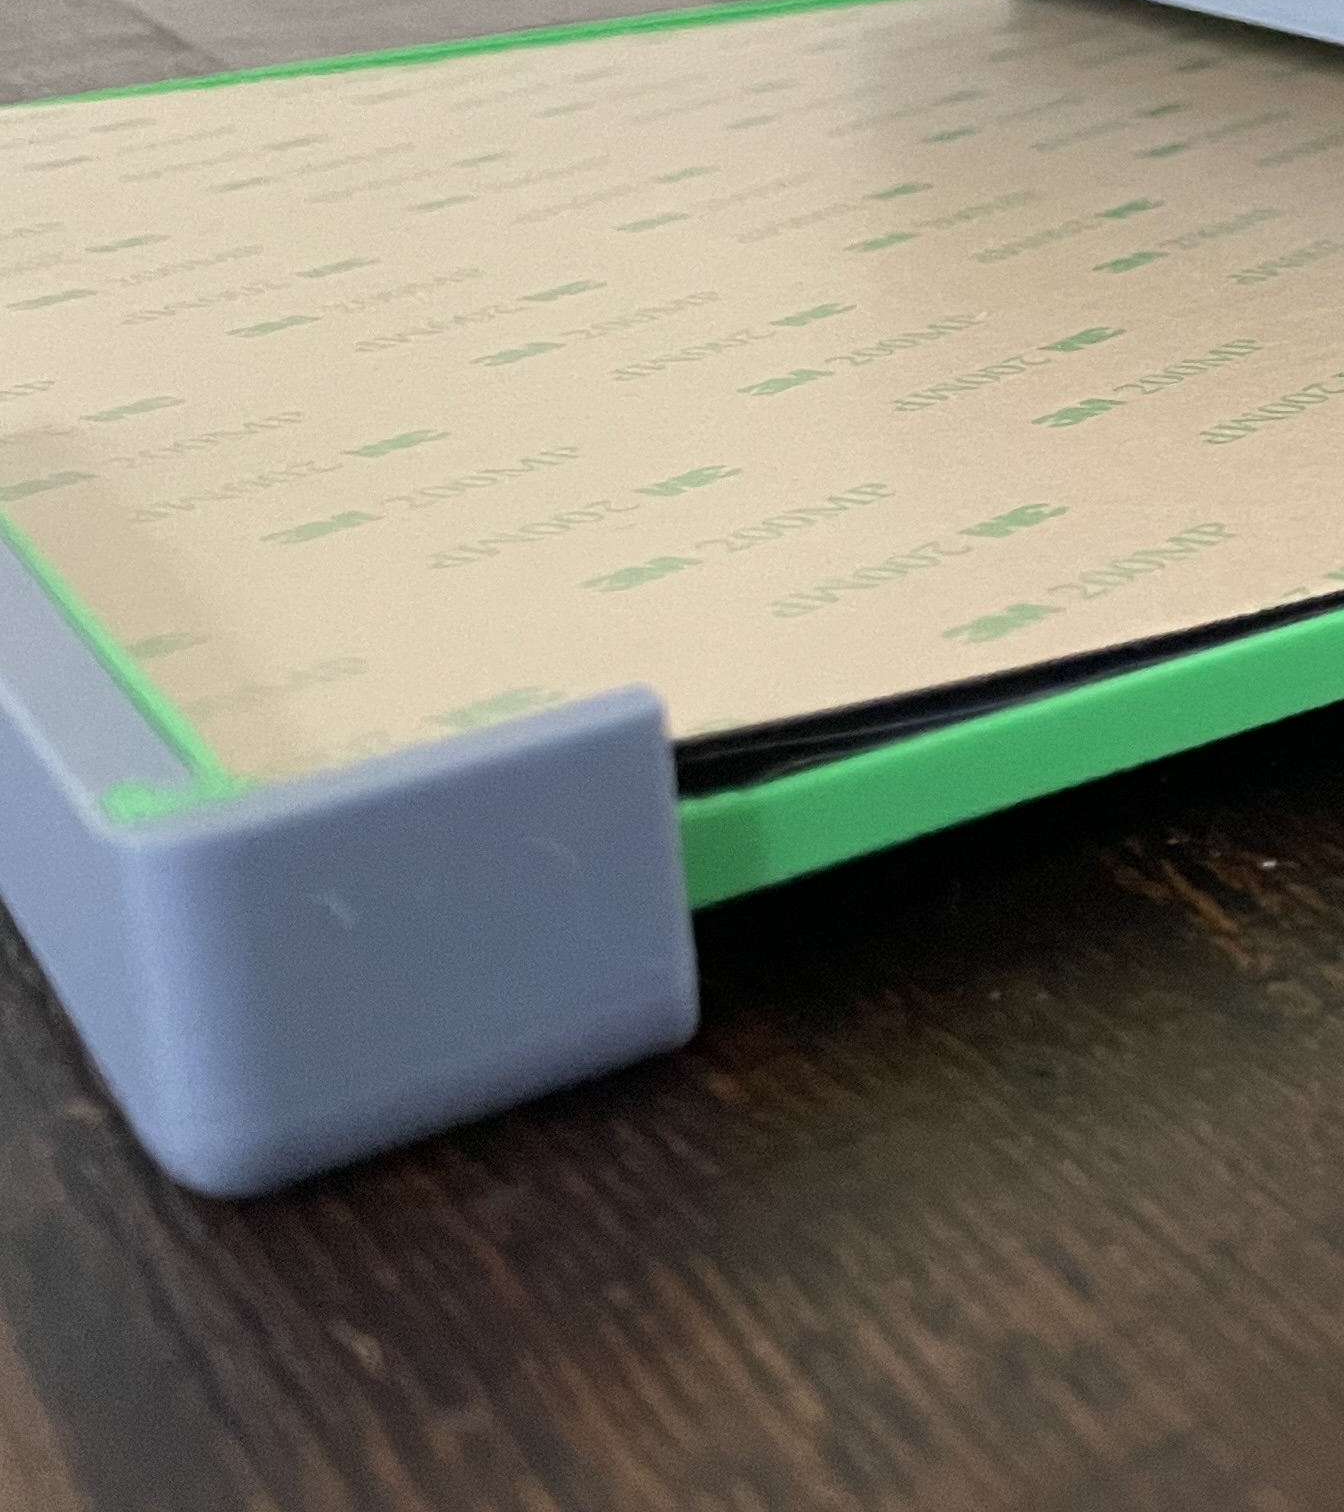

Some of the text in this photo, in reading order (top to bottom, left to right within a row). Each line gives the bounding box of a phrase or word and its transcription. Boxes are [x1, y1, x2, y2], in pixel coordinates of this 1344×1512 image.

[1112, 338, 1262, 395] 200MP
[770, 541, 973, 618] 200MP
[1047, 522, 1236, 598] 200MP
